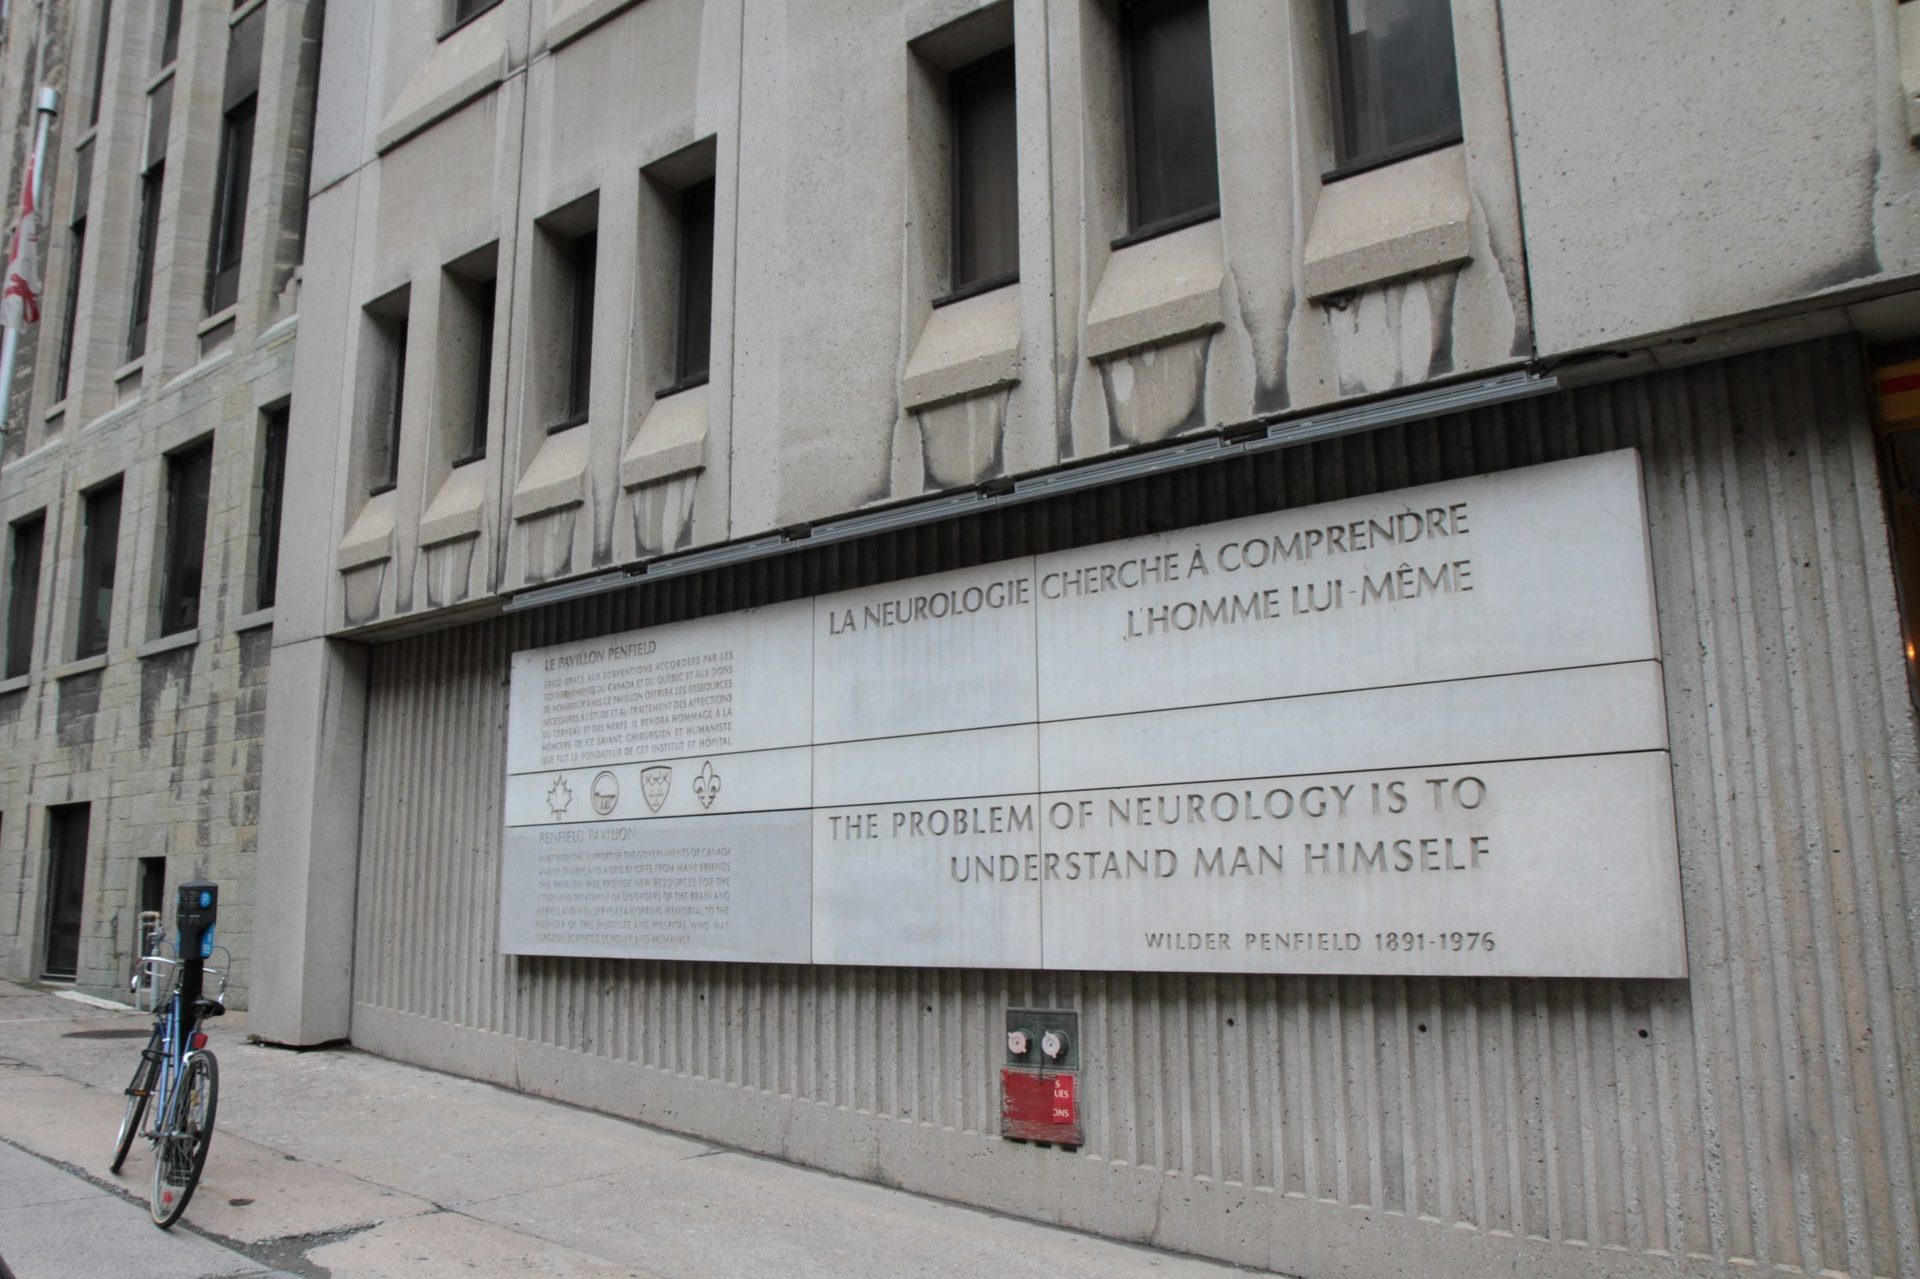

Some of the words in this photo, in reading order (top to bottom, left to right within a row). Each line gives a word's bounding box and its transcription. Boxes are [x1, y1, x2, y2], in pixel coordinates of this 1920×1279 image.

[829, 609, 857, 636] LA
[863, 578, 1029, 630] NEUROLOGIE
[1040, 553, 1179, 600] CHERCHE
[1187, 543, 1209, 579] À
[1217, 502, 1470, 572] COMPRENDRE
[1127, 589, 1280, 638] L'HOMME
[545, 659, 555, 671] LE
[558, 650, 605, 669] PAVILLON
[608, 640, 656, 661] PENFIELD
[608, 679, 635, 692] CANADA
[711, 664, 733, 677] DONS
[630, 701, 672, 716] TRAITEMENT
[688, 693, 733, 708] AFFECTIONS
[640, 715, 669, 728] RENDRA
[672, 710, 712, 724] HOMMAGE
[626, 728, 671, 742] CHIRURGIEN
[686, 721, 732, 736] HUMANISTE
[581, 748, 622, 760] FONDATEUR
[652, 741, 684, 753] INSTITUT
[828, 814, 878, 840] THE
[891, 805, 1034, 838] PROBLEM
[1049, 801, 1094, 830] OF
[1107, 783, 1355, 827] NEUROLOGY
[1371, 780, 1408, 814] IS
[1425, 776, 1487, 812] TO
[539, 830, 583, 844] PENFIELD
[588, 827, 636, 841] PAVILION
[702, 847, 731, 858] CANADA
[951, 848, 1178, 883] UNDERSTAND
[1193, 844, 1284, 877] MAN
[1304, 836, 1490, 874] HIMSELF
[655, 864, 675, 874] FROM
[677, 863, 699, 873] MANY
[700, 862, 731, 873] FRIENDS
[690, 892, 713, 901] BRAIN
[713, 891, 729, 901] AND
[652, 920, 687, 930] HOSPITAL
[690, 921, 709, 930] WHO
[1145, 932, 1230, 951] WILDER
[1245, 932, 1361, 951] PENFIELD
[1374, 931, 1496, 951] 1891-1976
